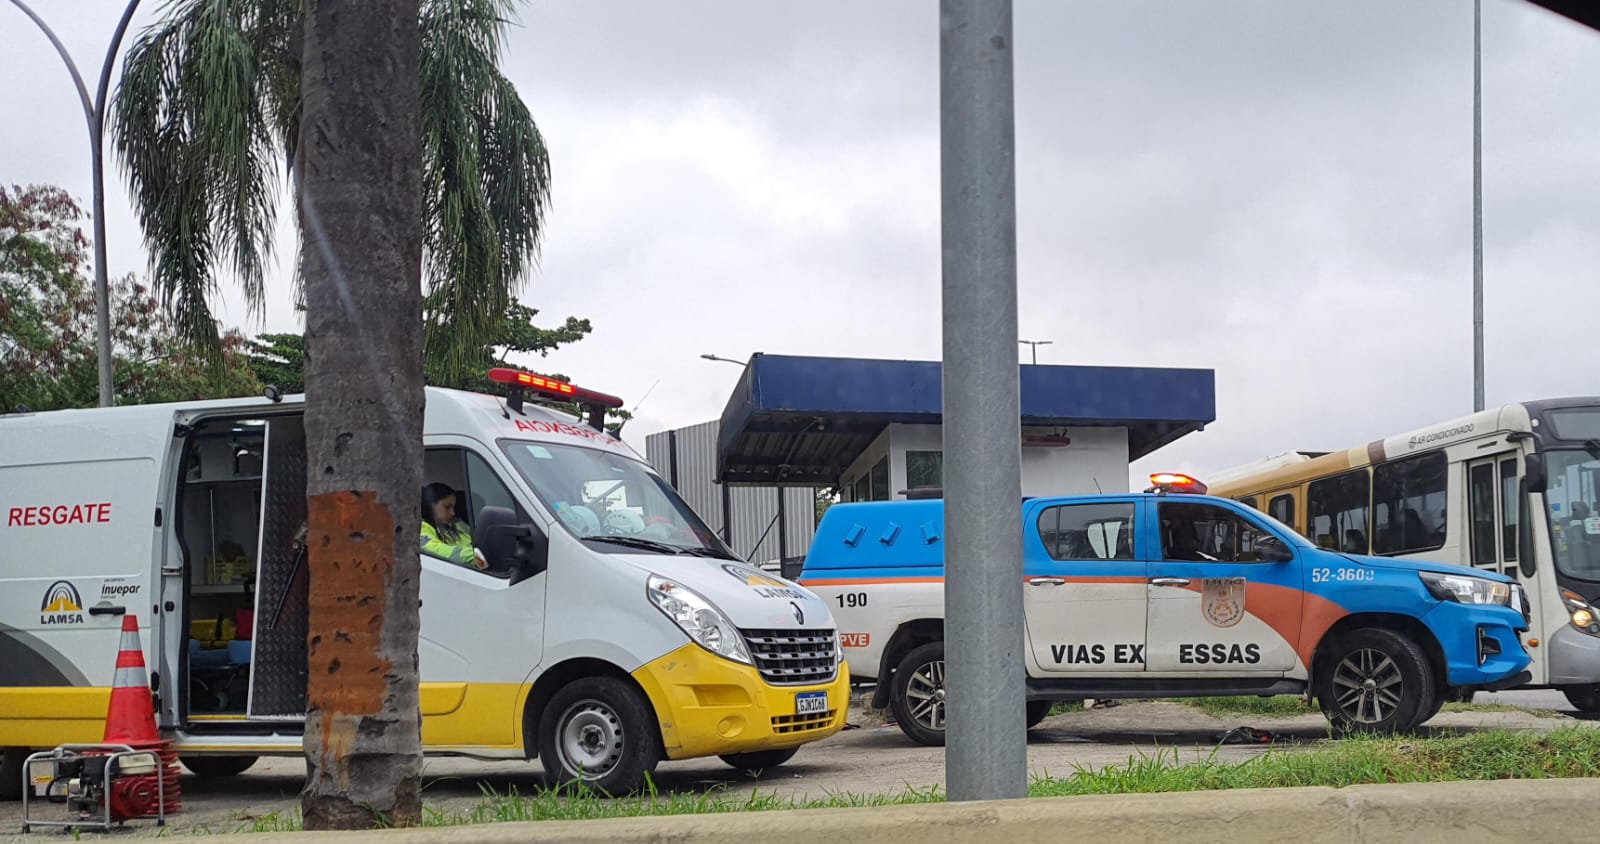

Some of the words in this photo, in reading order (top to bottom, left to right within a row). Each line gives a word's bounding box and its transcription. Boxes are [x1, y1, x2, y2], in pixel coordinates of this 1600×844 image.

[1427, 423, 1475, 443] CONDICIONADO
[8, 502, 111, 527] RESGATE
[101, 584, 141, 597] invepar
[753, 588, 809, 601] LAMSA
[836, 592, 867, 608] 190
[41, 614, 84, 624] LAMSA
[1051, 644, 1106, 664] VIAS
